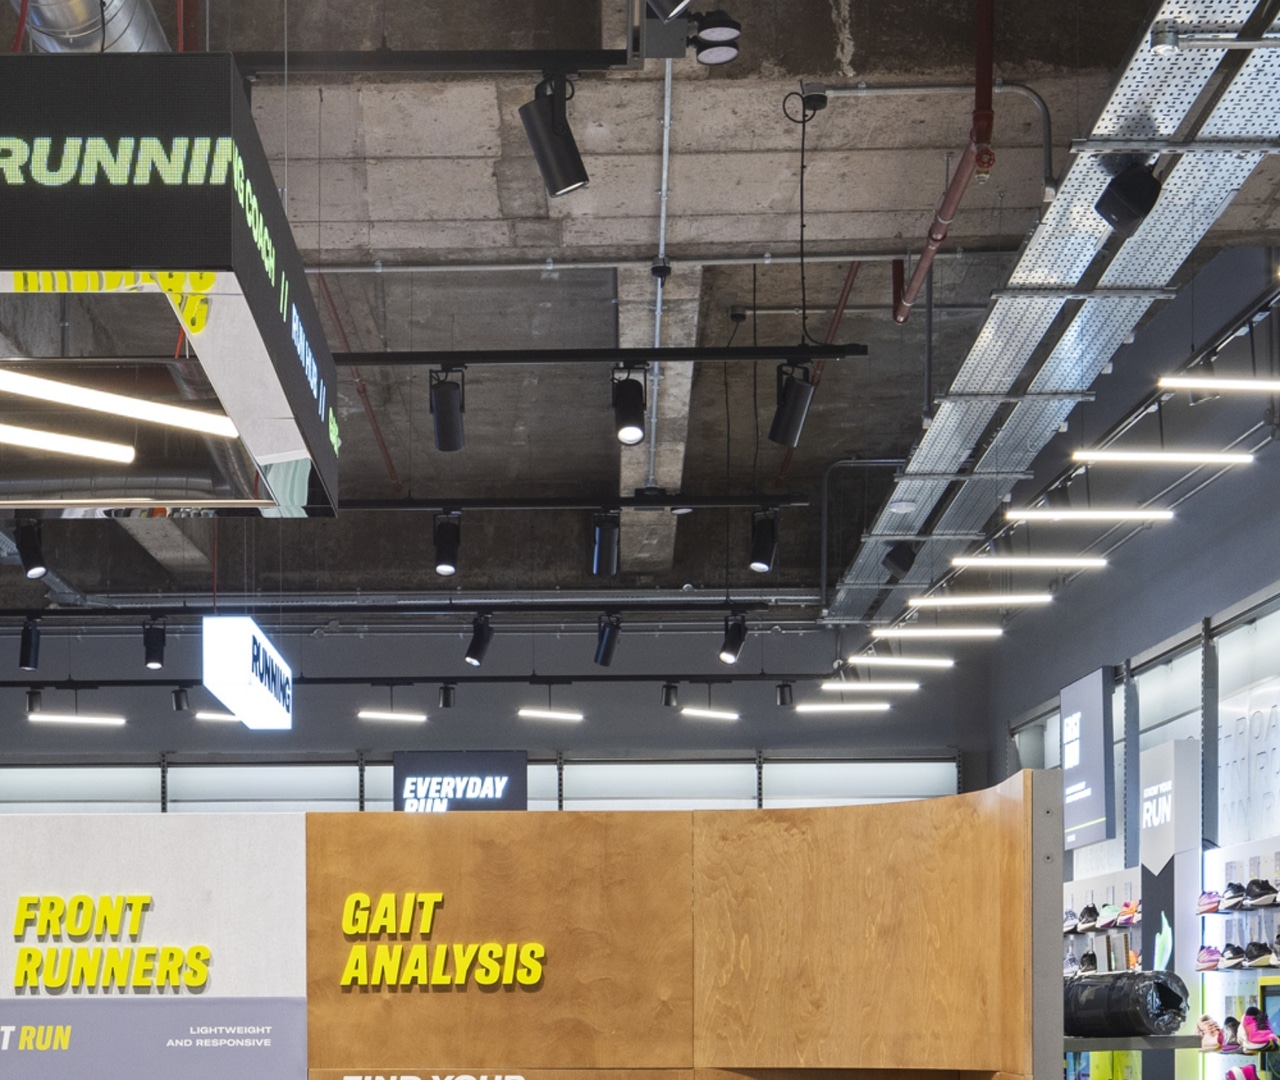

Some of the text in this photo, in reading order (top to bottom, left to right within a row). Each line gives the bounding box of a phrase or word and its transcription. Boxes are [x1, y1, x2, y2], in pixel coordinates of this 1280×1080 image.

[251, 634, 291, 714] RUNNING
[402, 776, 509, 799] EVERYDAY
[1142, 794, 1172, 829] RUN
[13, 894, 153, 938] FRONT
[340, 892, 443, 936] GAIT
[13, 945, 212, 990] RUNNERS
[340, 942, 545, 987] ANALYSIS
[18, 1025, 72, 1052] RUN
[166, 1038, 272, 1047] AND RESPONSIVE
[189, 1026, 272, 1035] LIGHTWEIGHT
